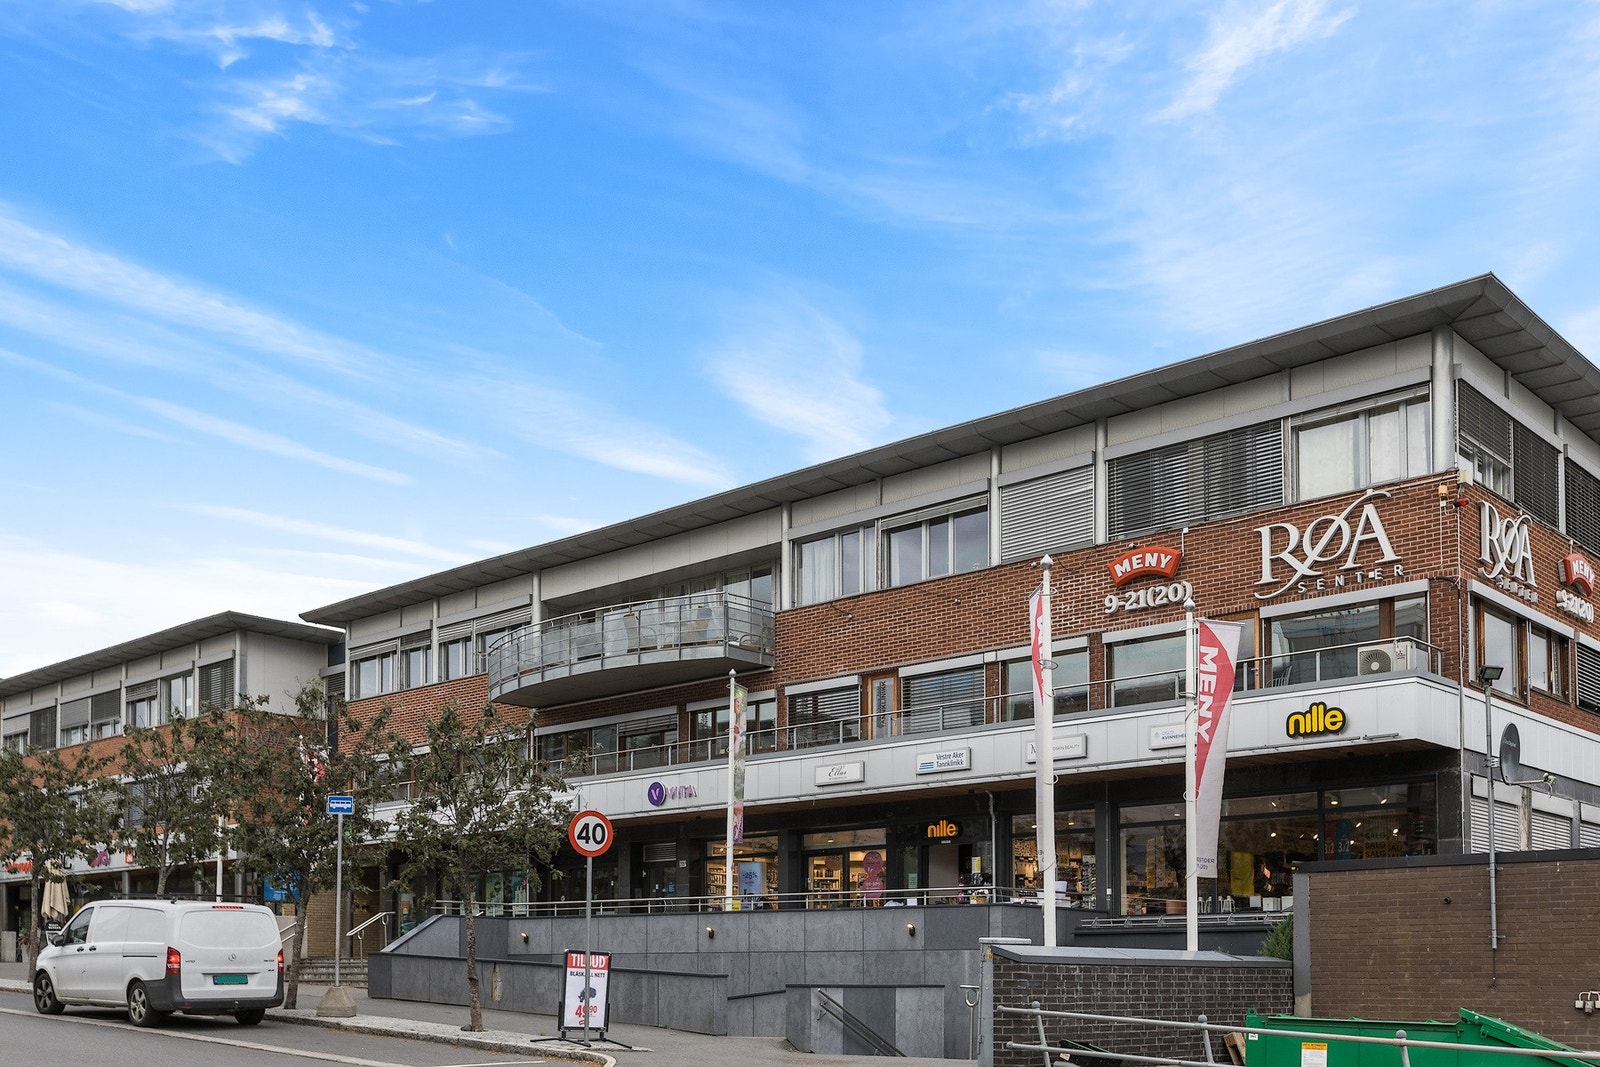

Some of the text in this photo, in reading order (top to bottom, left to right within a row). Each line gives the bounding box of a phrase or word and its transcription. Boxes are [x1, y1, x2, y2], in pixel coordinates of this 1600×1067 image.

[1253, 491, 1402, 599] RØA
[1477, 500, 1538, 587] RØA
[1114, 552, 1173, 578] MENY
[1297, 564, 1405, 594] SENTER
[1104, 581, 1193, 614] 9-21(20)
[1196, 646, 1219, 744] MENY
[1288, 703, 1343, 735] nille
[936, 753, 951, 761] Vestre
[936, 759, 964, 768] Tannklinikk
[666, 785, 697, 799] VITA
[576, 822, 606, 846] 40
[927, 820, 957, 838] nille
[571, 953, 606, 968] TILUD
